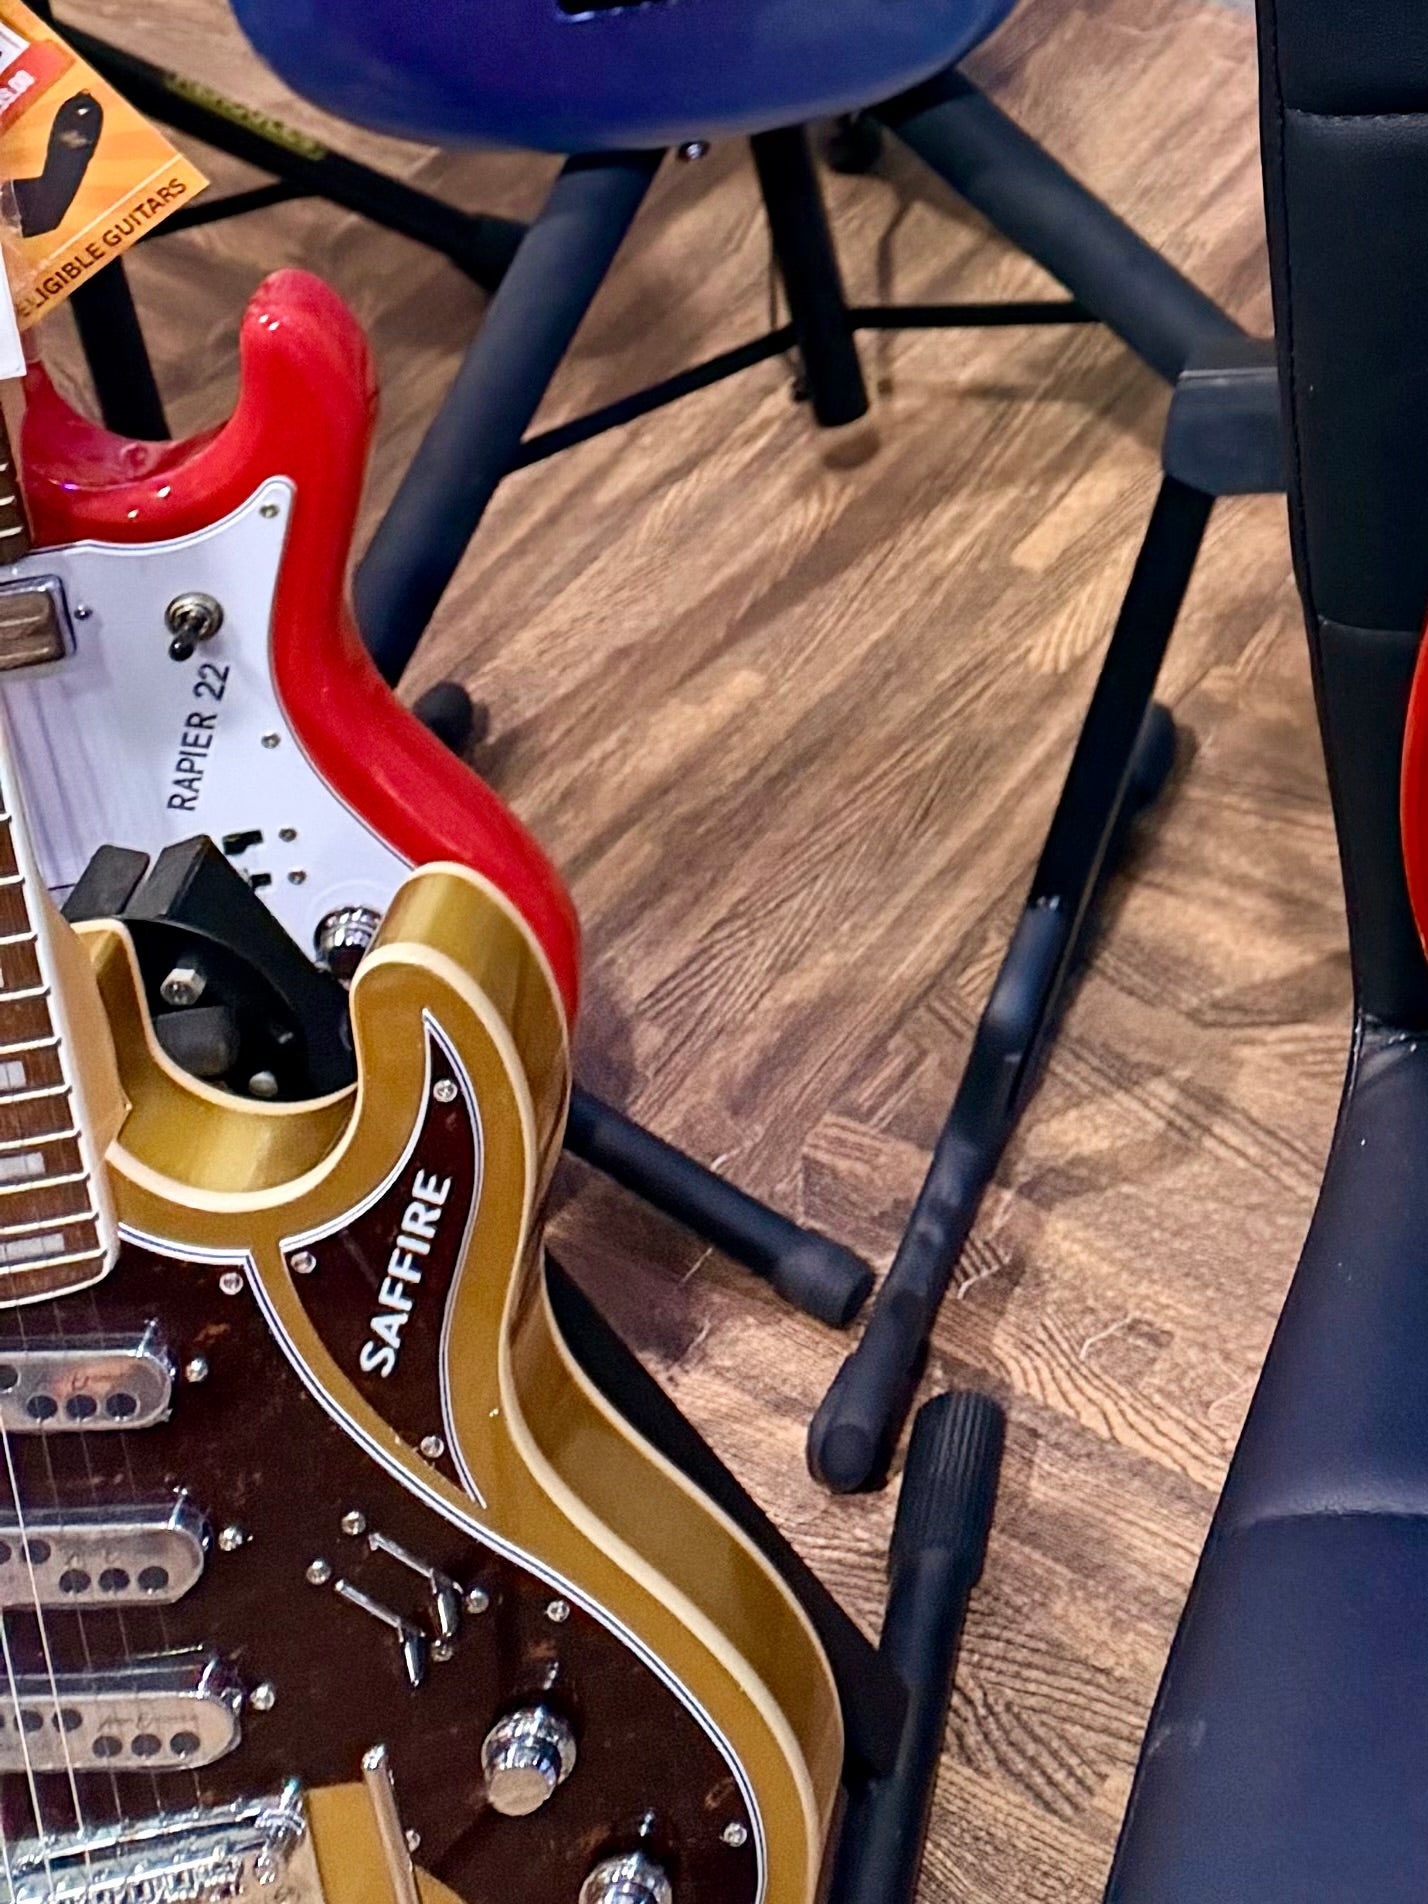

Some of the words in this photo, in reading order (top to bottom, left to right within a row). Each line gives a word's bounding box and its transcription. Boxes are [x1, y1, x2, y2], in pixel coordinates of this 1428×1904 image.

[102, 176, 189, 248] GUITARS
[166, 710, 219, 813] RAPIER
[193, 663, 232, 706] 22
[359, 1167, 453, 1379] SAFFIRE
